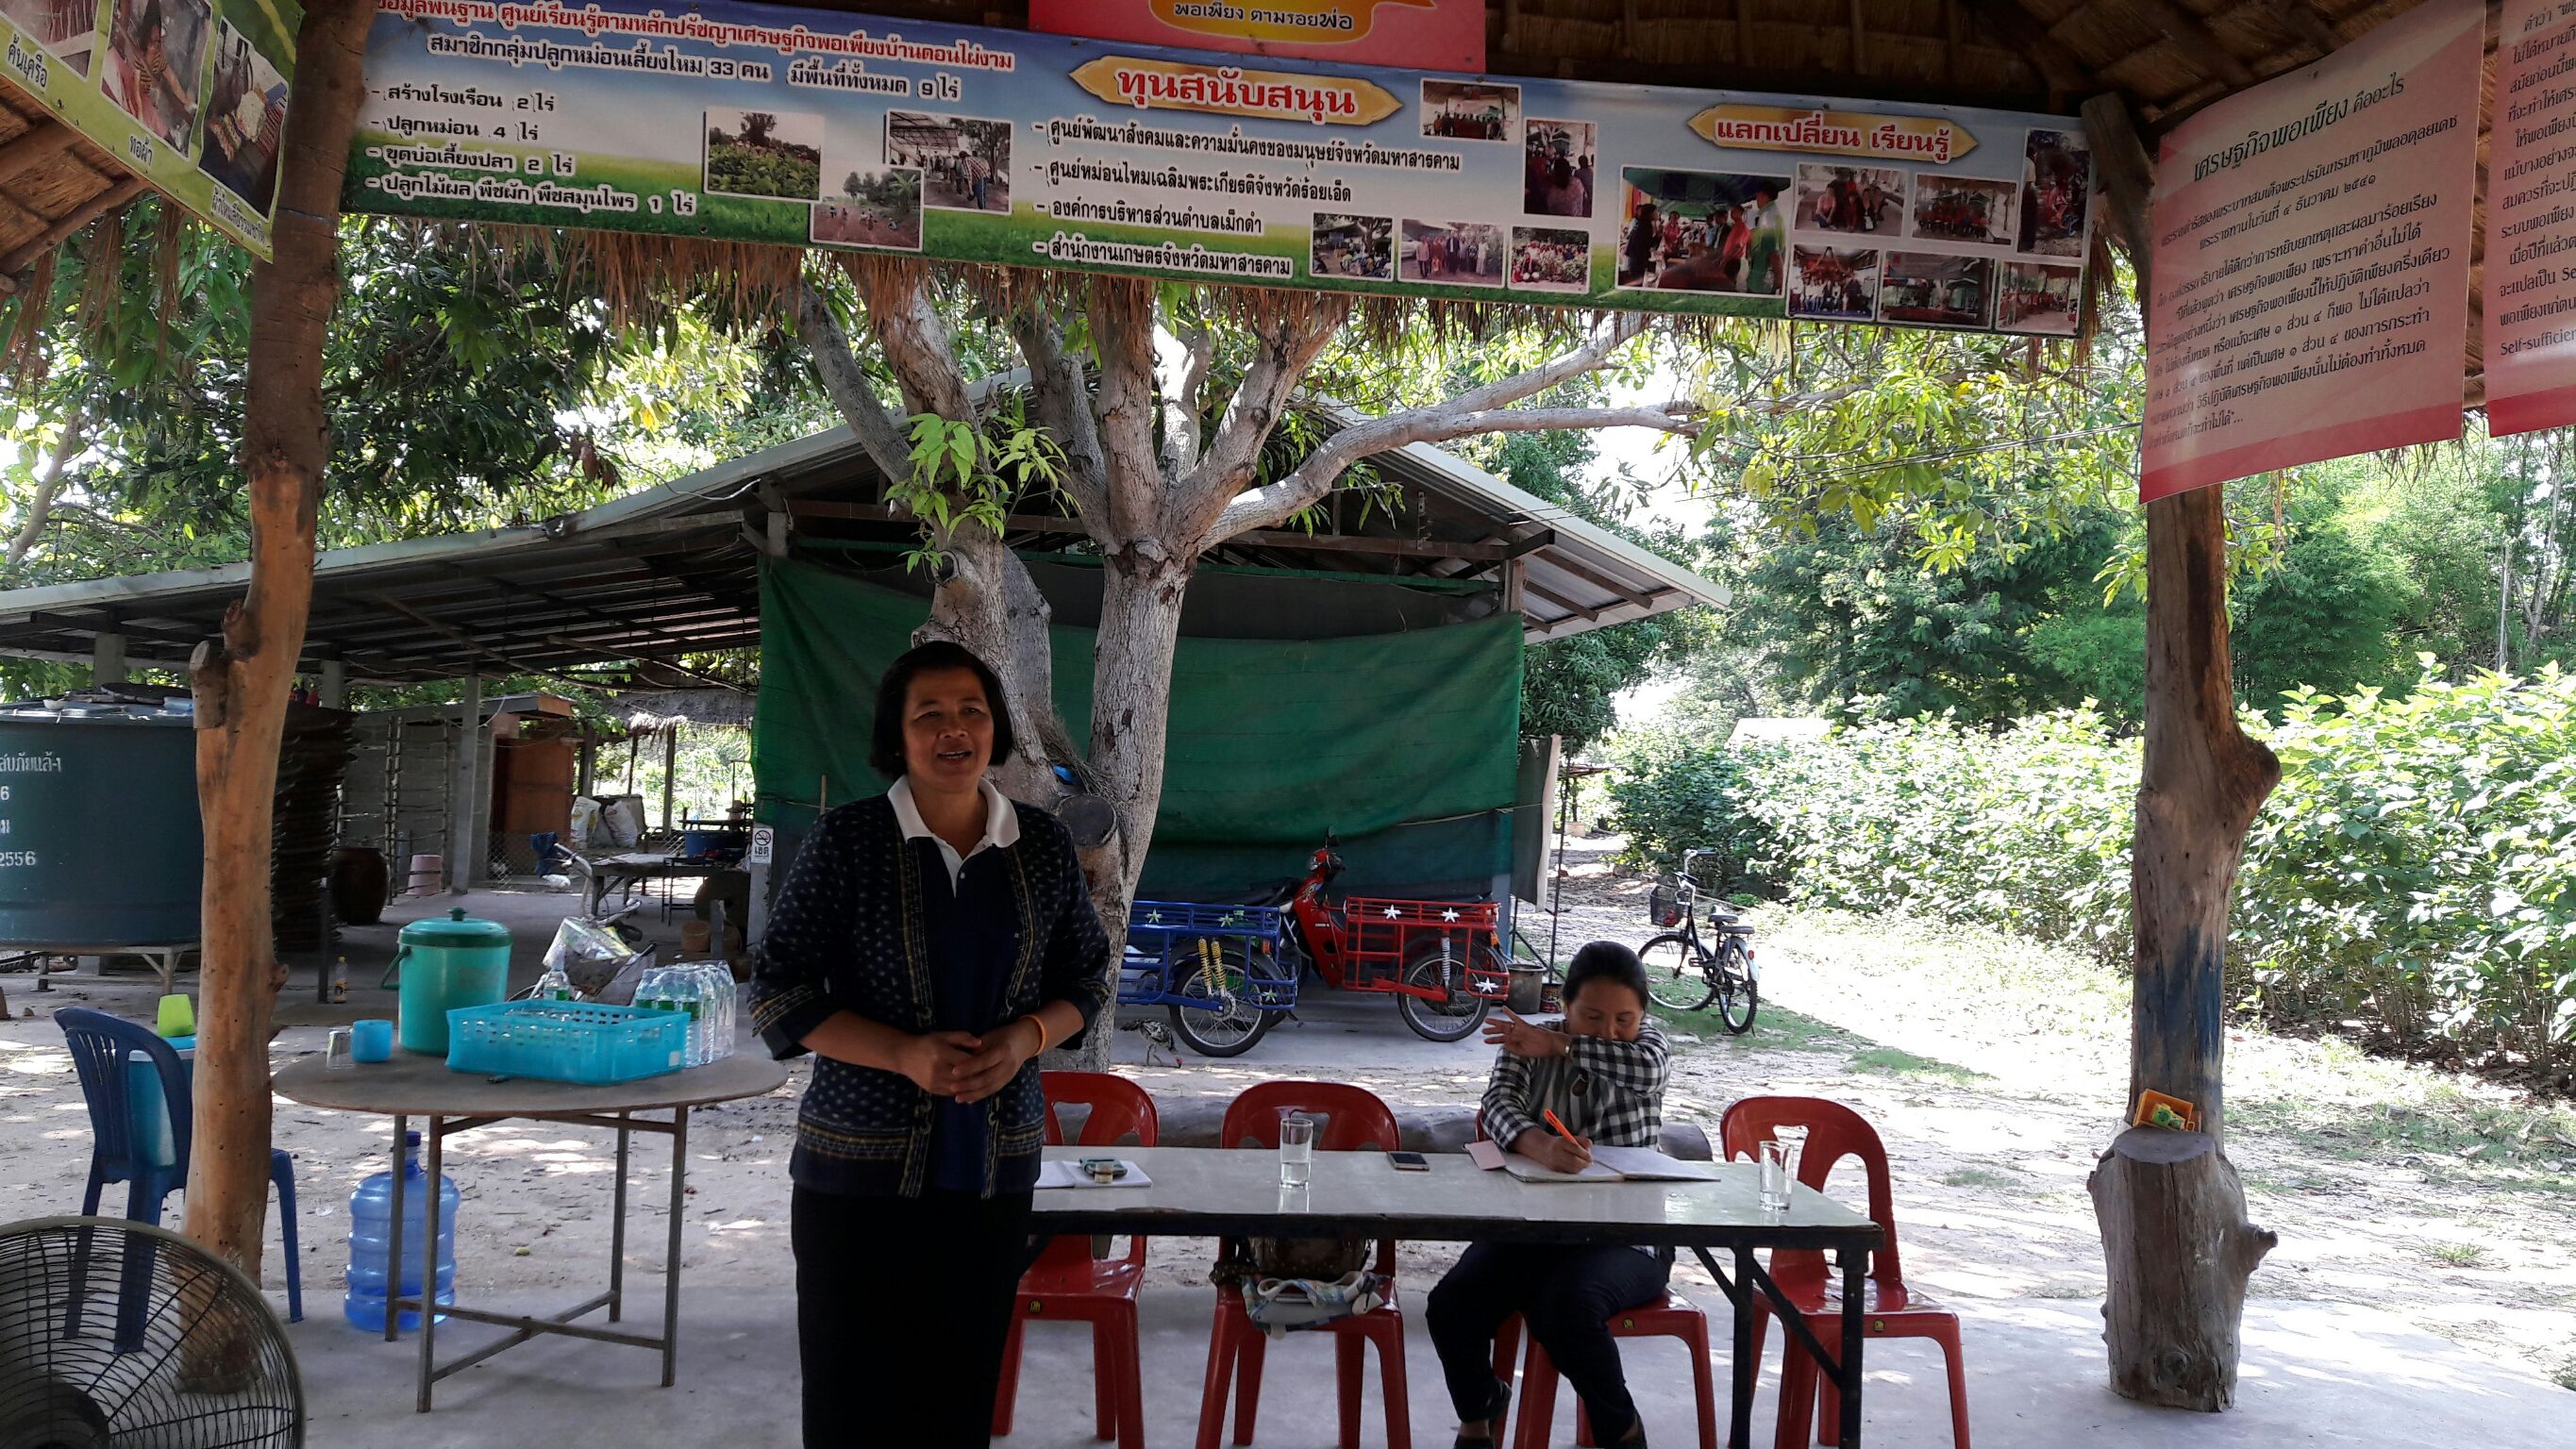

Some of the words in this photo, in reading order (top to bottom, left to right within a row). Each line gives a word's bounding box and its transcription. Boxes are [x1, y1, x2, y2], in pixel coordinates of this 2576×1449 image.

[1175, 2, 1244, 21] พอเพียง
[1251, 8, 1352, 30] ตามรอยพ่อ
[431, 34, 702, 75] สมาชิกกลุ่มปลูกหม่อนเลี้ยงไหม
[711, 60, 733, 75] 33
[742, 63, 769, 79] คน
[791, 58, 908, 93] มีพื้นที่ทั้งหมด
[921, 82, 933, 96] 9
[940, 76, 959, 98] ไร่
[388, 84, 503, 108] สร้างโรงเรือน
[517, 97, 527, 108] 2
[537, 92, 554, 111] ไร่
[1118, 68, 1356, 122] ทุนสนับสนุน
[388, 115, 478, 138] ปลูกหม่อน
[493, 125, 506, 138] 4
[520, 121, 538, 141] ไร่
[1717, 112, 1860, 146] แลกเปลี่ยน
[1872, 125, 1950, 162] เรียนรู้
[2194, 99, 2349, 182] เศรษฐกิจพอเพียง
[2353, 72, 2405, 113] คืออะไร
[129, 135, 154, 167] ทอผ้า
[387, 143, 512, 170] ขุดบ่อเลี้ยงปลา
[527, 158, 540, 171] 2
[554, 154, 572, 174] ไร่
[385, 175, 470, 199] ปลูกไม้ผล
[478, 179, 529, 201] พืชผัก
[537, 188, 635, 212] พืชสมุนไพร
[675, 192, 694, 213] ไร่
[1052, 196, 1263, 235] องค์การบริหารส่วนตำบลเม็กดำ
[1052, 237, 1291, 276] สำนักงานเกษตรจังหวัดมหาสารคาม
